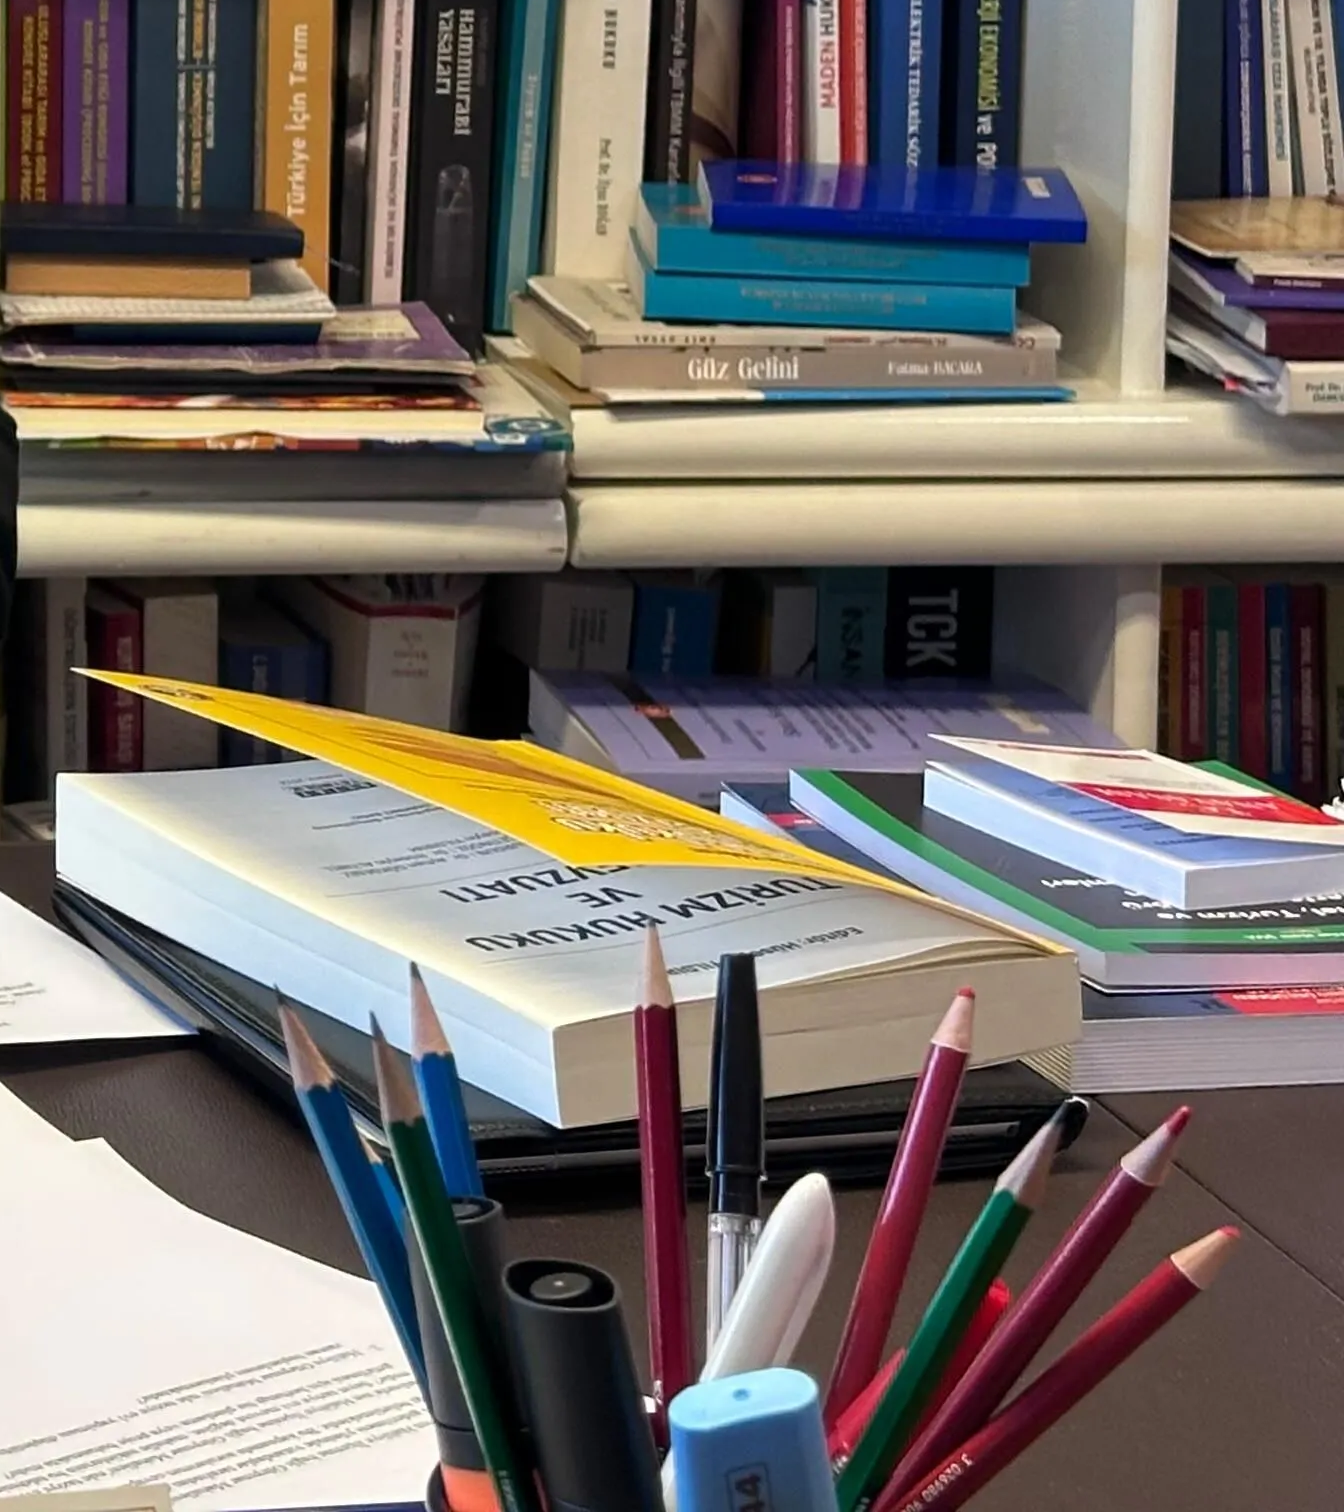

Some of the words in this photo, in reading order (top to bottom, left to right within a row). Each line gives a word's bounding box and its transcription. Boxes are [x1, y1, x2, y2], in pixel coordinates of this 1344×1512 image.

[289, 23, 308, 86] Tarım
[819, 42, 835, 109] MADEN
[284, 92, 311, 132] İçin
[978, 114, 994, 135] ve
[285, 137, 310, 219] Türkiye
[688, 357, 729, 380] Güz
[737, 357, 799, 380] Gelini
[906, 588, 958, 667] TCK
[565, 885, 643, 910] VE
[659, 875, 843, 922] TURİZM
[463, 909, 664, 952] HUKUKU
